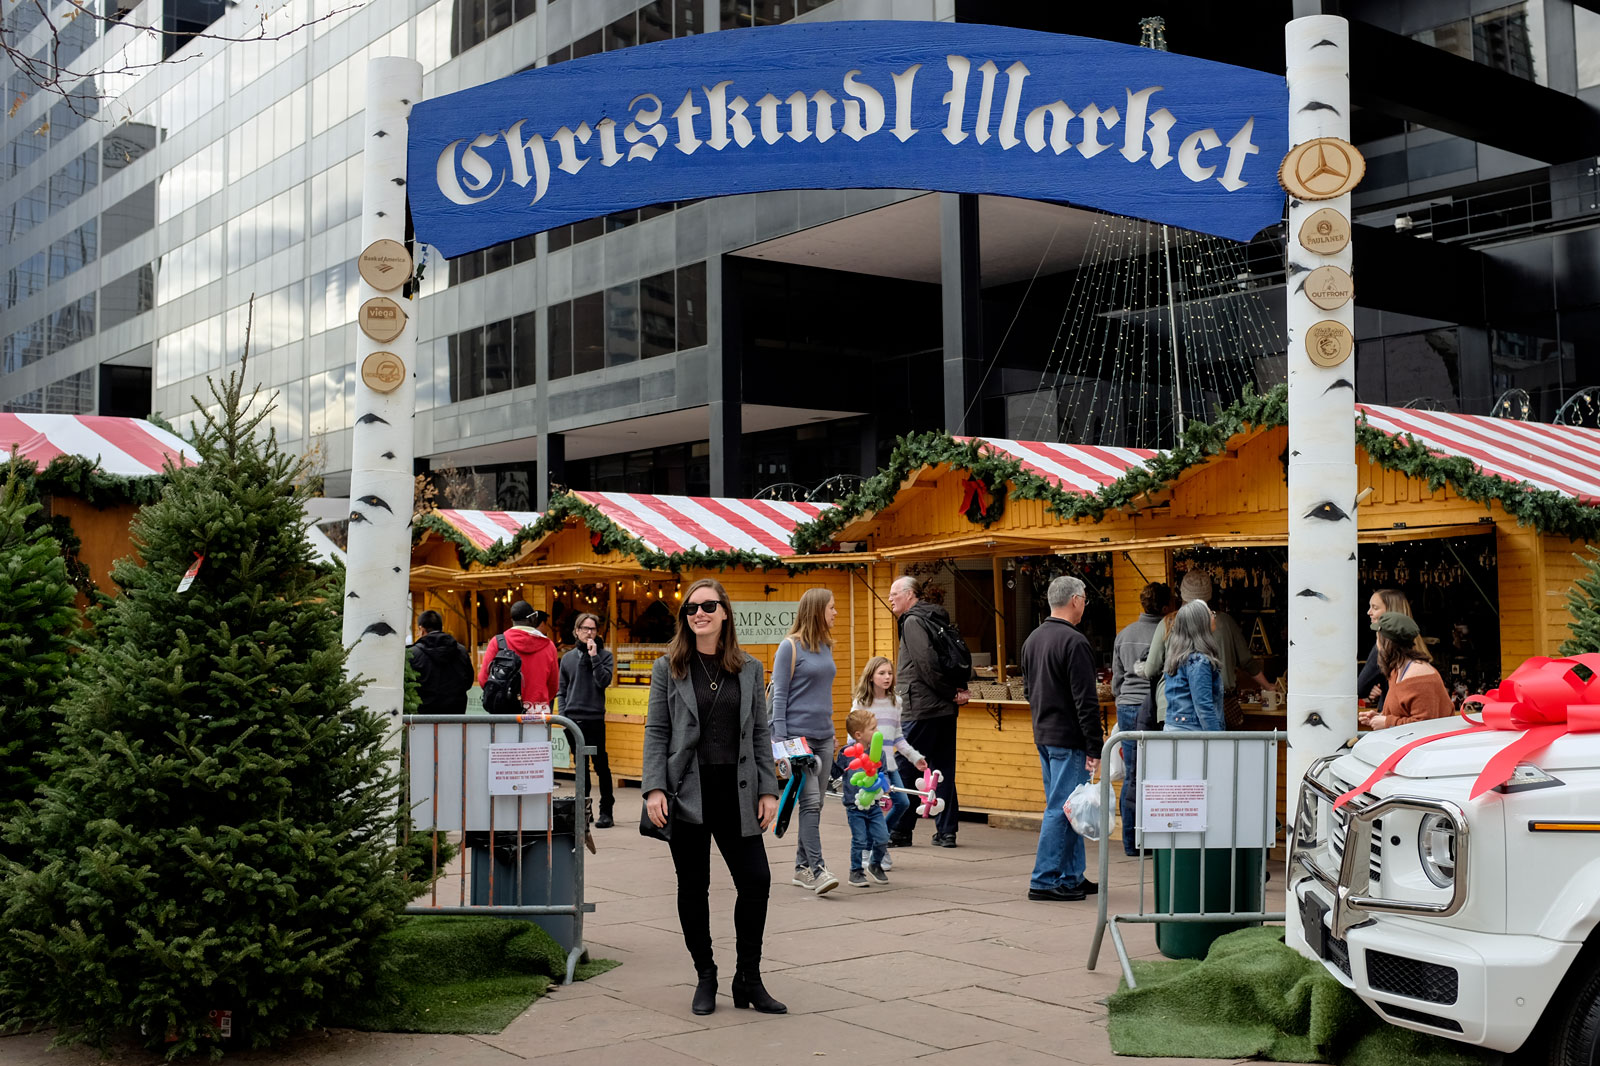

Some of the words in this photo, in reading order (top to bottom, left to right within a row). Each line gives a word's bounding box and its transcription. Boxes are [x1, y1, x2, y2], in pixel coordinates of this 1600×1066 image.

[942, 55, 1261, 193] Market
[1307, 234, 1345, 245] PAULANER
[1327, 290, 1349, 298] FRONT
[369, 308, 394, 319] viega
[733, 611, 762, 627] EMP
[764, 612, 777, 627] &
[755, 628, 772, 636] AND
[773, 628, 788, 636] EXT
[606, 696, 626, 706] HONEY
